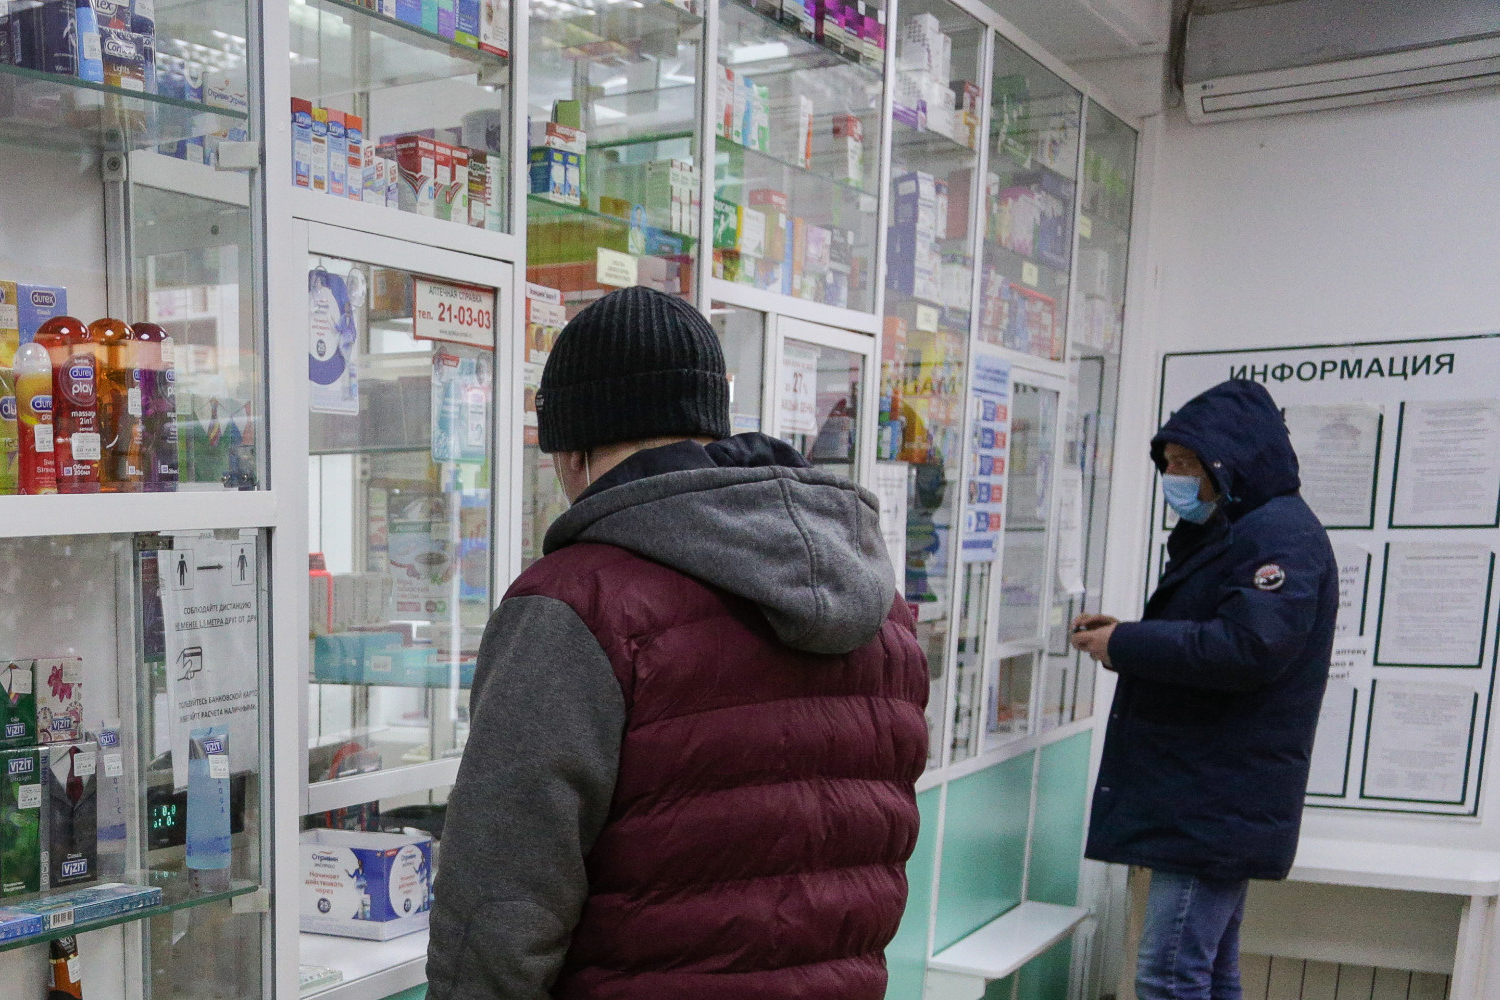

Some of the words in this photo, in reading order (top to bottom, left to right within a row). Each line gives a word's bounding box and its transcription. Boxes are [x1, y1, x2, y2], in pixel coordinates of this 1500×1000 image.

[438, 302, 491, 329] 21-03-03
[1229, 353, 1455, 383] ИНФОРМАЦИЯ
[184, 604, 219, 615] СОБЛЮДАЙТЕ
[207, 618, 224, 627] МЕТРА
[201, 709, 224, 719] РАСЧЕТА
